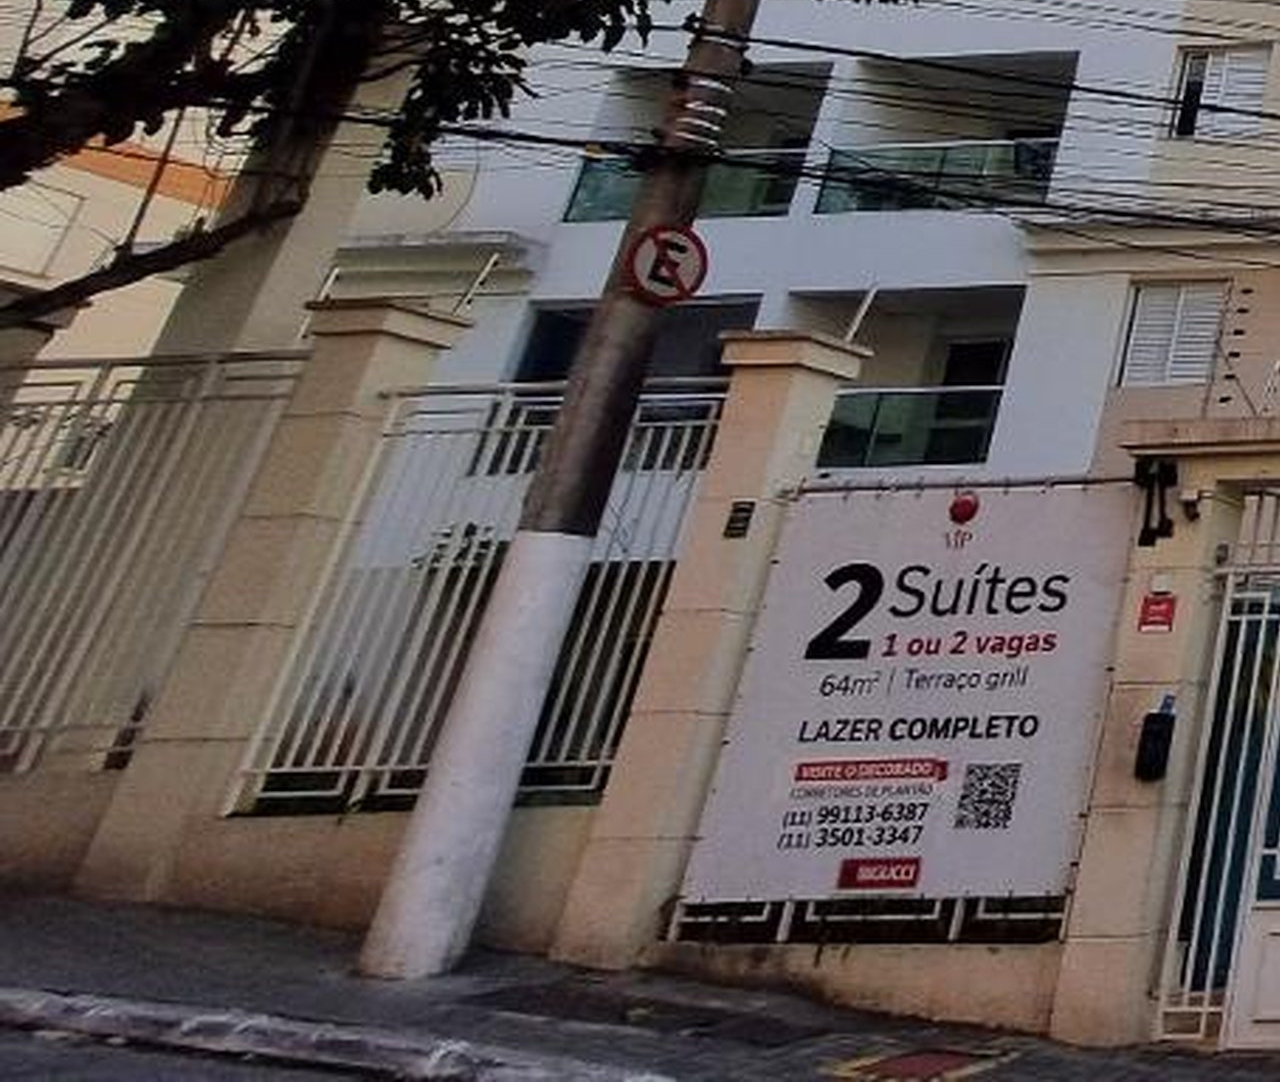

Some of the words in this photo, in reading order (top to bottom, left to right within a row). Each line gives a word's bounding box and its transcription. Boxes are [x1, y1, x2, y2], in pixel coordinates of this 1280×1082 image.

[647, 239, 689, 288] E
[804, 563, 885, 660] 2
[889, 562, 1071, 619] Suítes
[881, 633, 899, 658] 1
[906, 635, 943, 657] ou
[949, 630, 969, 655] 2
[976, 632, 1058, 659] vagas
[903, 668, 981, 694] Terraço
[985, 667, 1028, 692] grill
[798, 719, 883, 743] LAZER
[888, 714, 1040, 741] COMPLETO
[815, 824, 925, 848] 3501-3347
